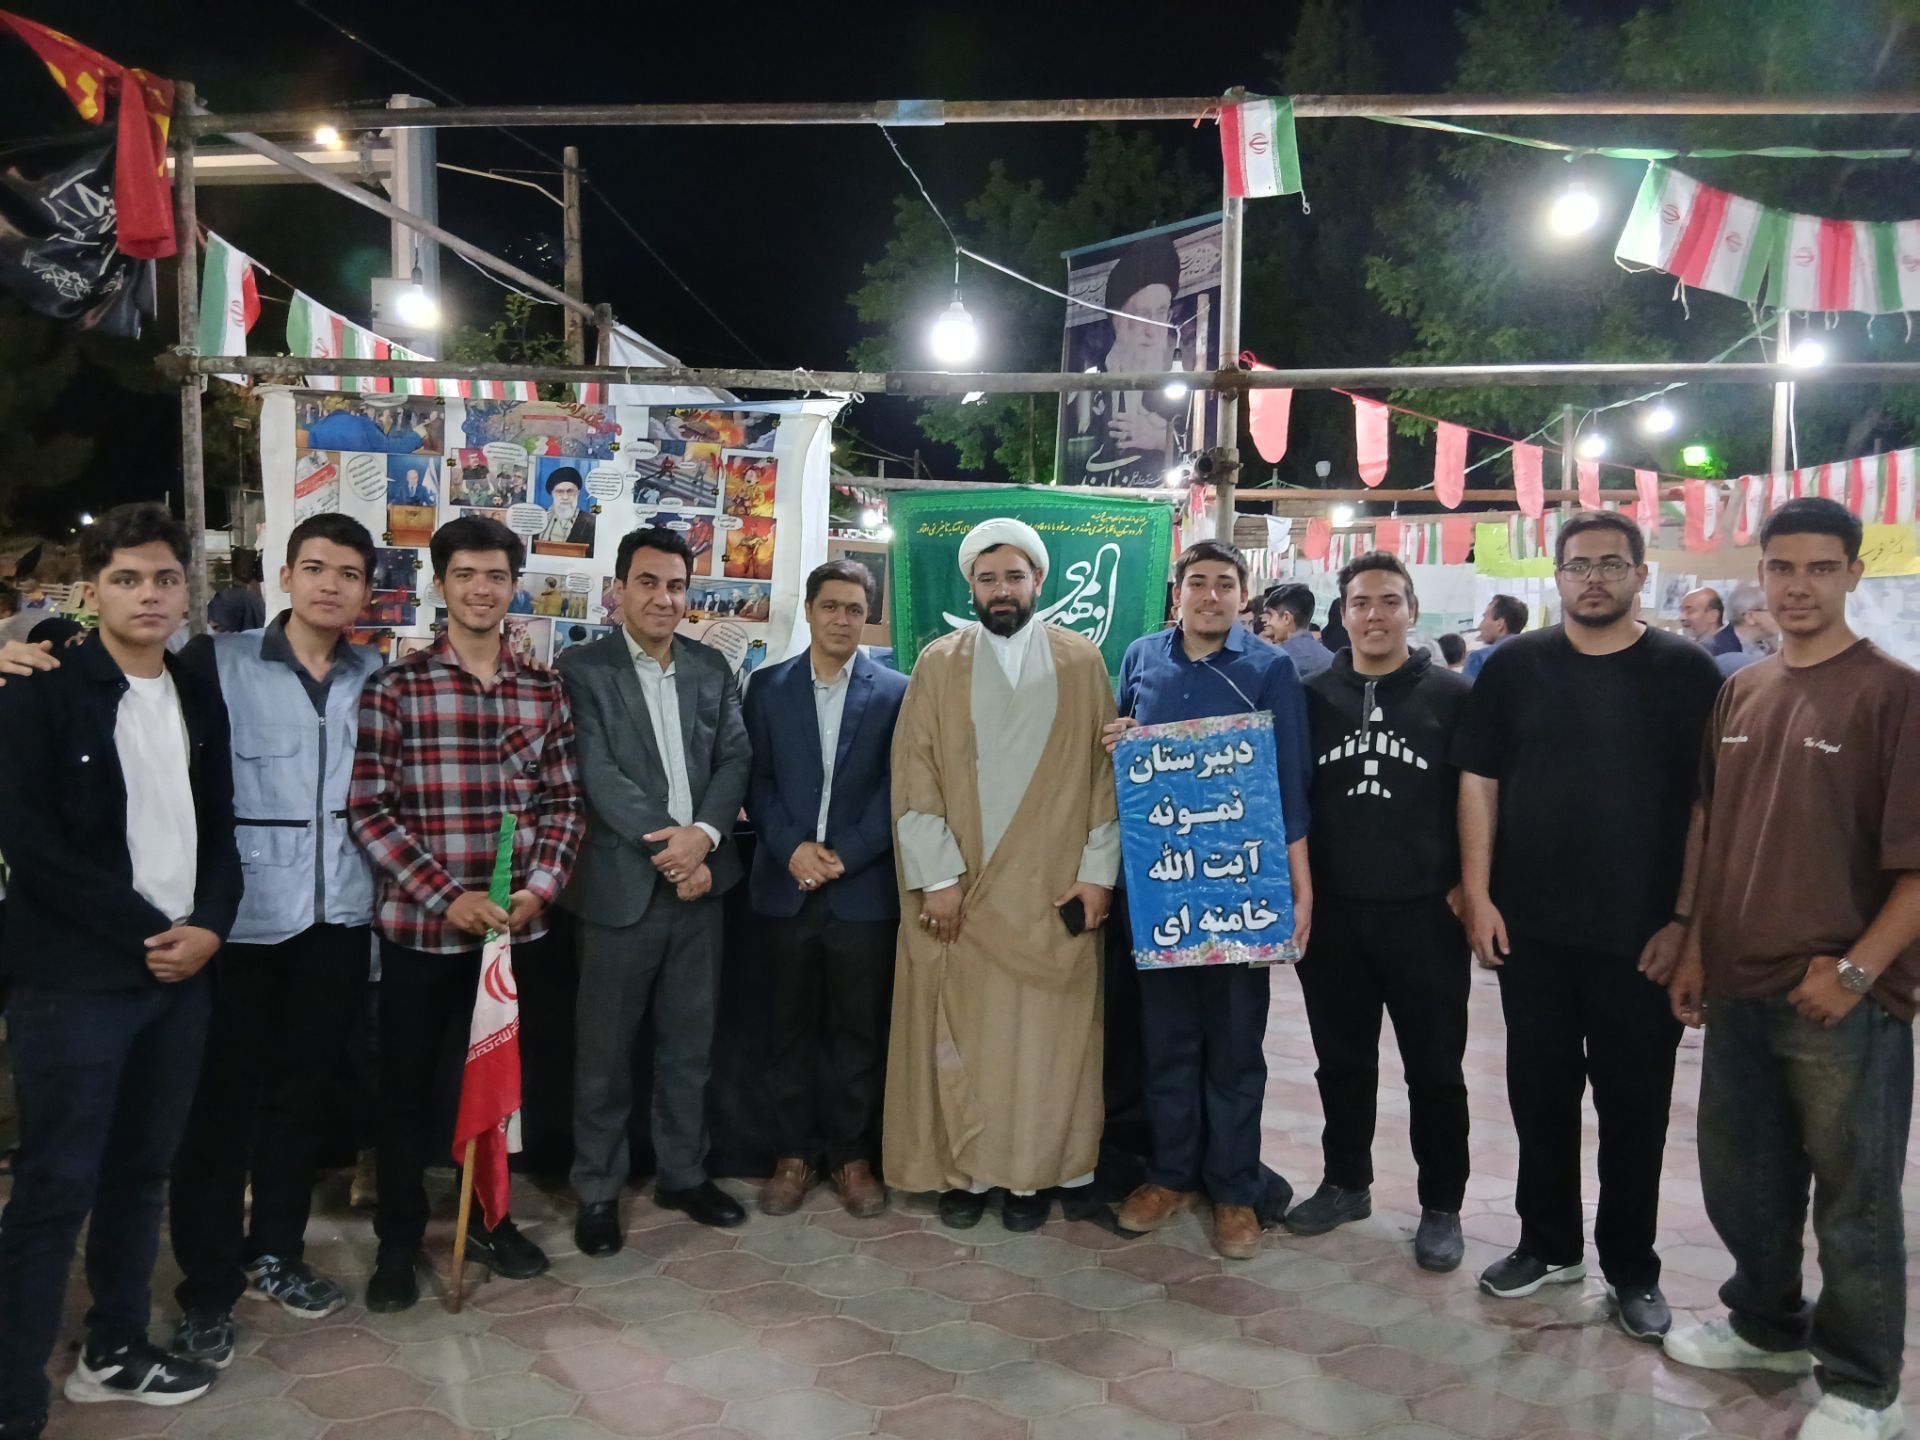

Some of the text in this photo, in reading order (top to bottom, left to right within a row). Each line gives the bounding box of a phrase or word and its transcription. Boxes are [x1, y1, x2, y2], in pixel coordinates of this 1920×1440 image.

[1128, 738, 1255, 784] دبیرستان
[1147, 788, 1245, 836] نمونه
[1148, 838, 1263, 884] آیت الله
[1152, 897, 1280, 948] خامنه ای
